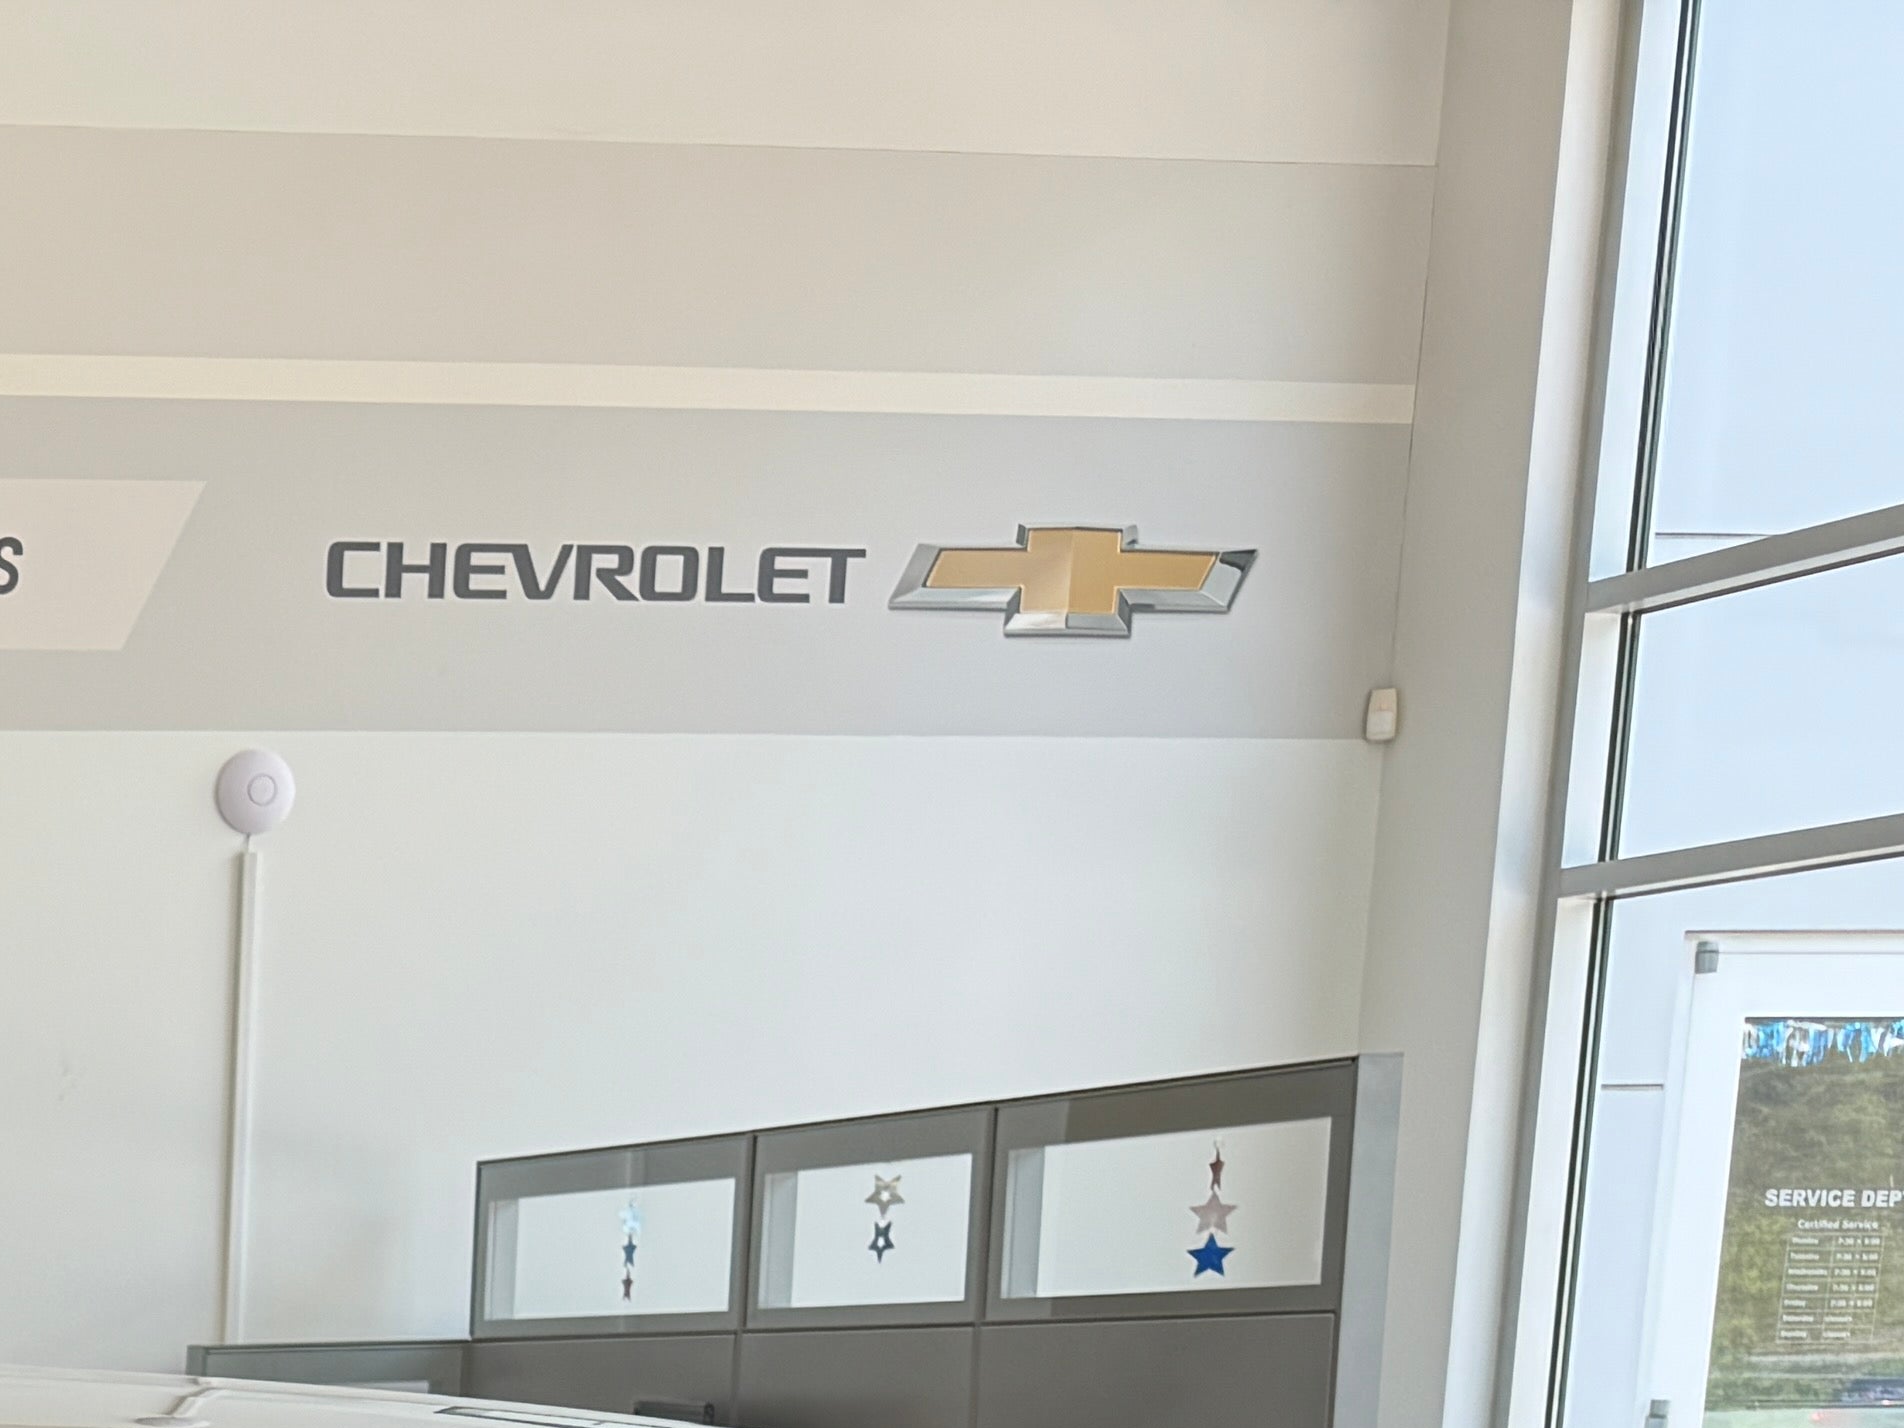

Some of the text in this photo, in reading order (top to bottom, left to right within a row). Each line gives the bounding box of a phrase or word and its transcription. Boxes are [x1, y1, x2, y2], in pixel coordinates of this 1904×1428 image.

[325, 540, 868, 605] CHEVROLET
[1764, 1188, 1904, 1208] SERVICE DEP
[1797, 1219, 1879, 1231] Certified Service
